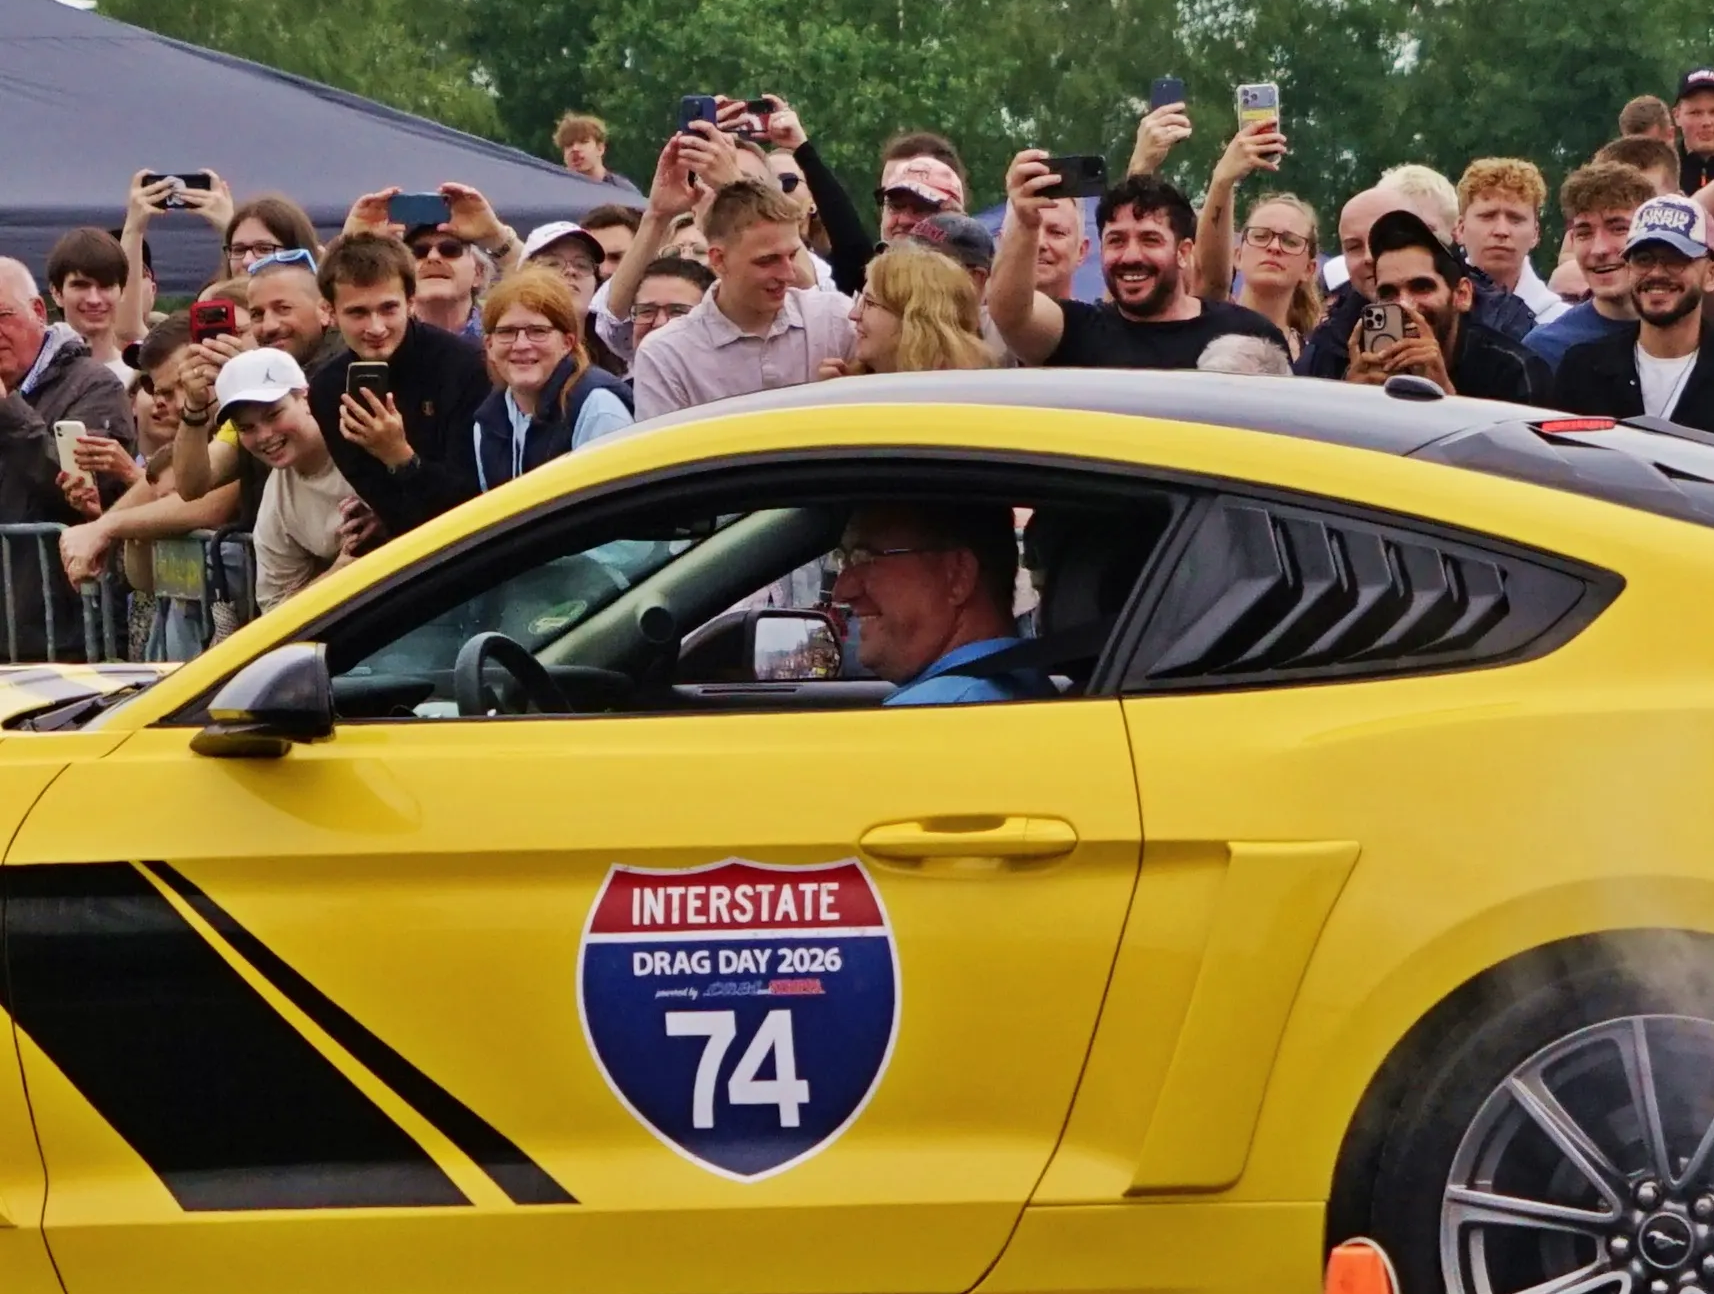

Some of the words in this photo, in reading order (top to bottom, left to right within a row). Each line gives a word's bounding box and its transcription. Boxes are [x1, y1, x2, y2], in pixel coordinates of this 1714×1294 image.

[632, 882, 841, 926] INTERSTATE
[632, 949, 712, 976] DRAG
[718, 948, 772, 974] DAY
[777, 946, 842, 973] 2026
[665, 1009, 810, 1129] 74
